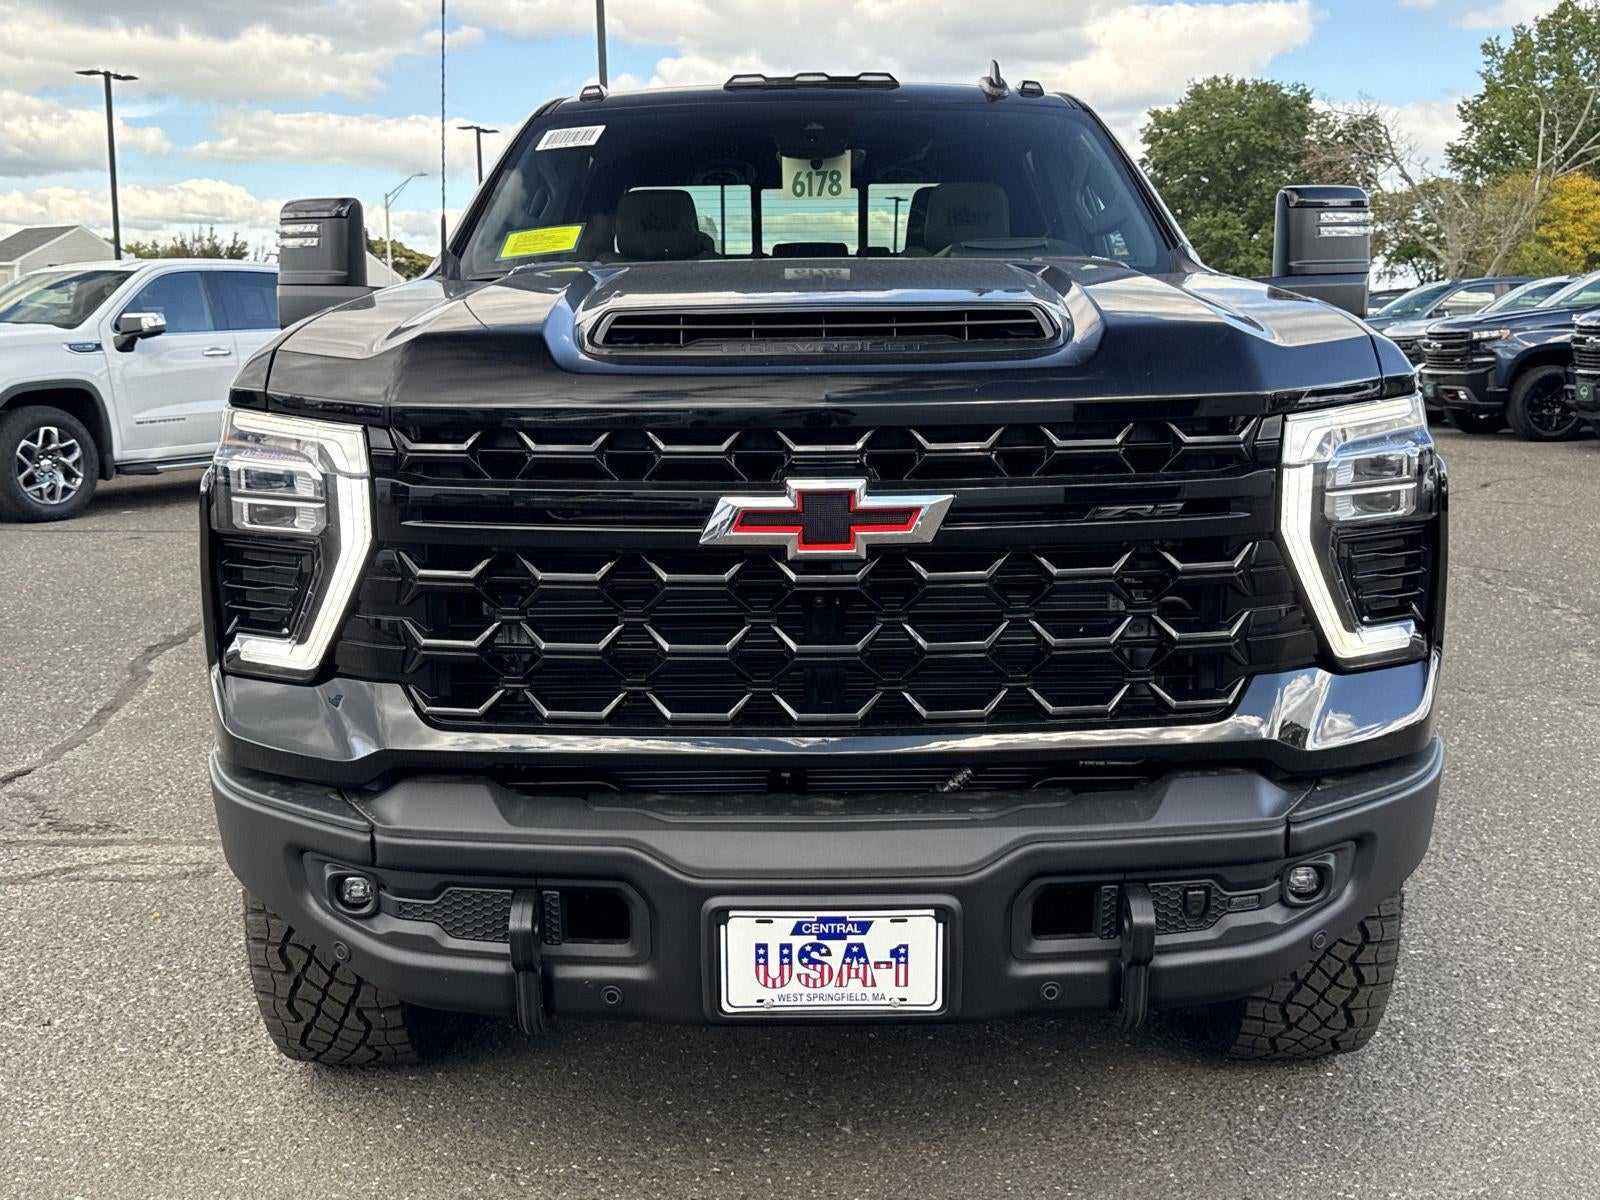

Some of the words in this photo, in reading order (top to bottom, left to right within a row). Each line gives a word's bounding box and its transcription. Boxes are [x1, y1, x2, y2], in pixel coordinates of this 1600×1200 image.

[792, 170, 842, 197] 6178
[801, 923, 861, 935] CENTRAL
[754, 942, 909, 988] USA-1
[777, 993, 803, 1003] WEST
[806, 993, 870, 1003] SPRINGFIELD,
[872, 992, 886, 1002] MA
